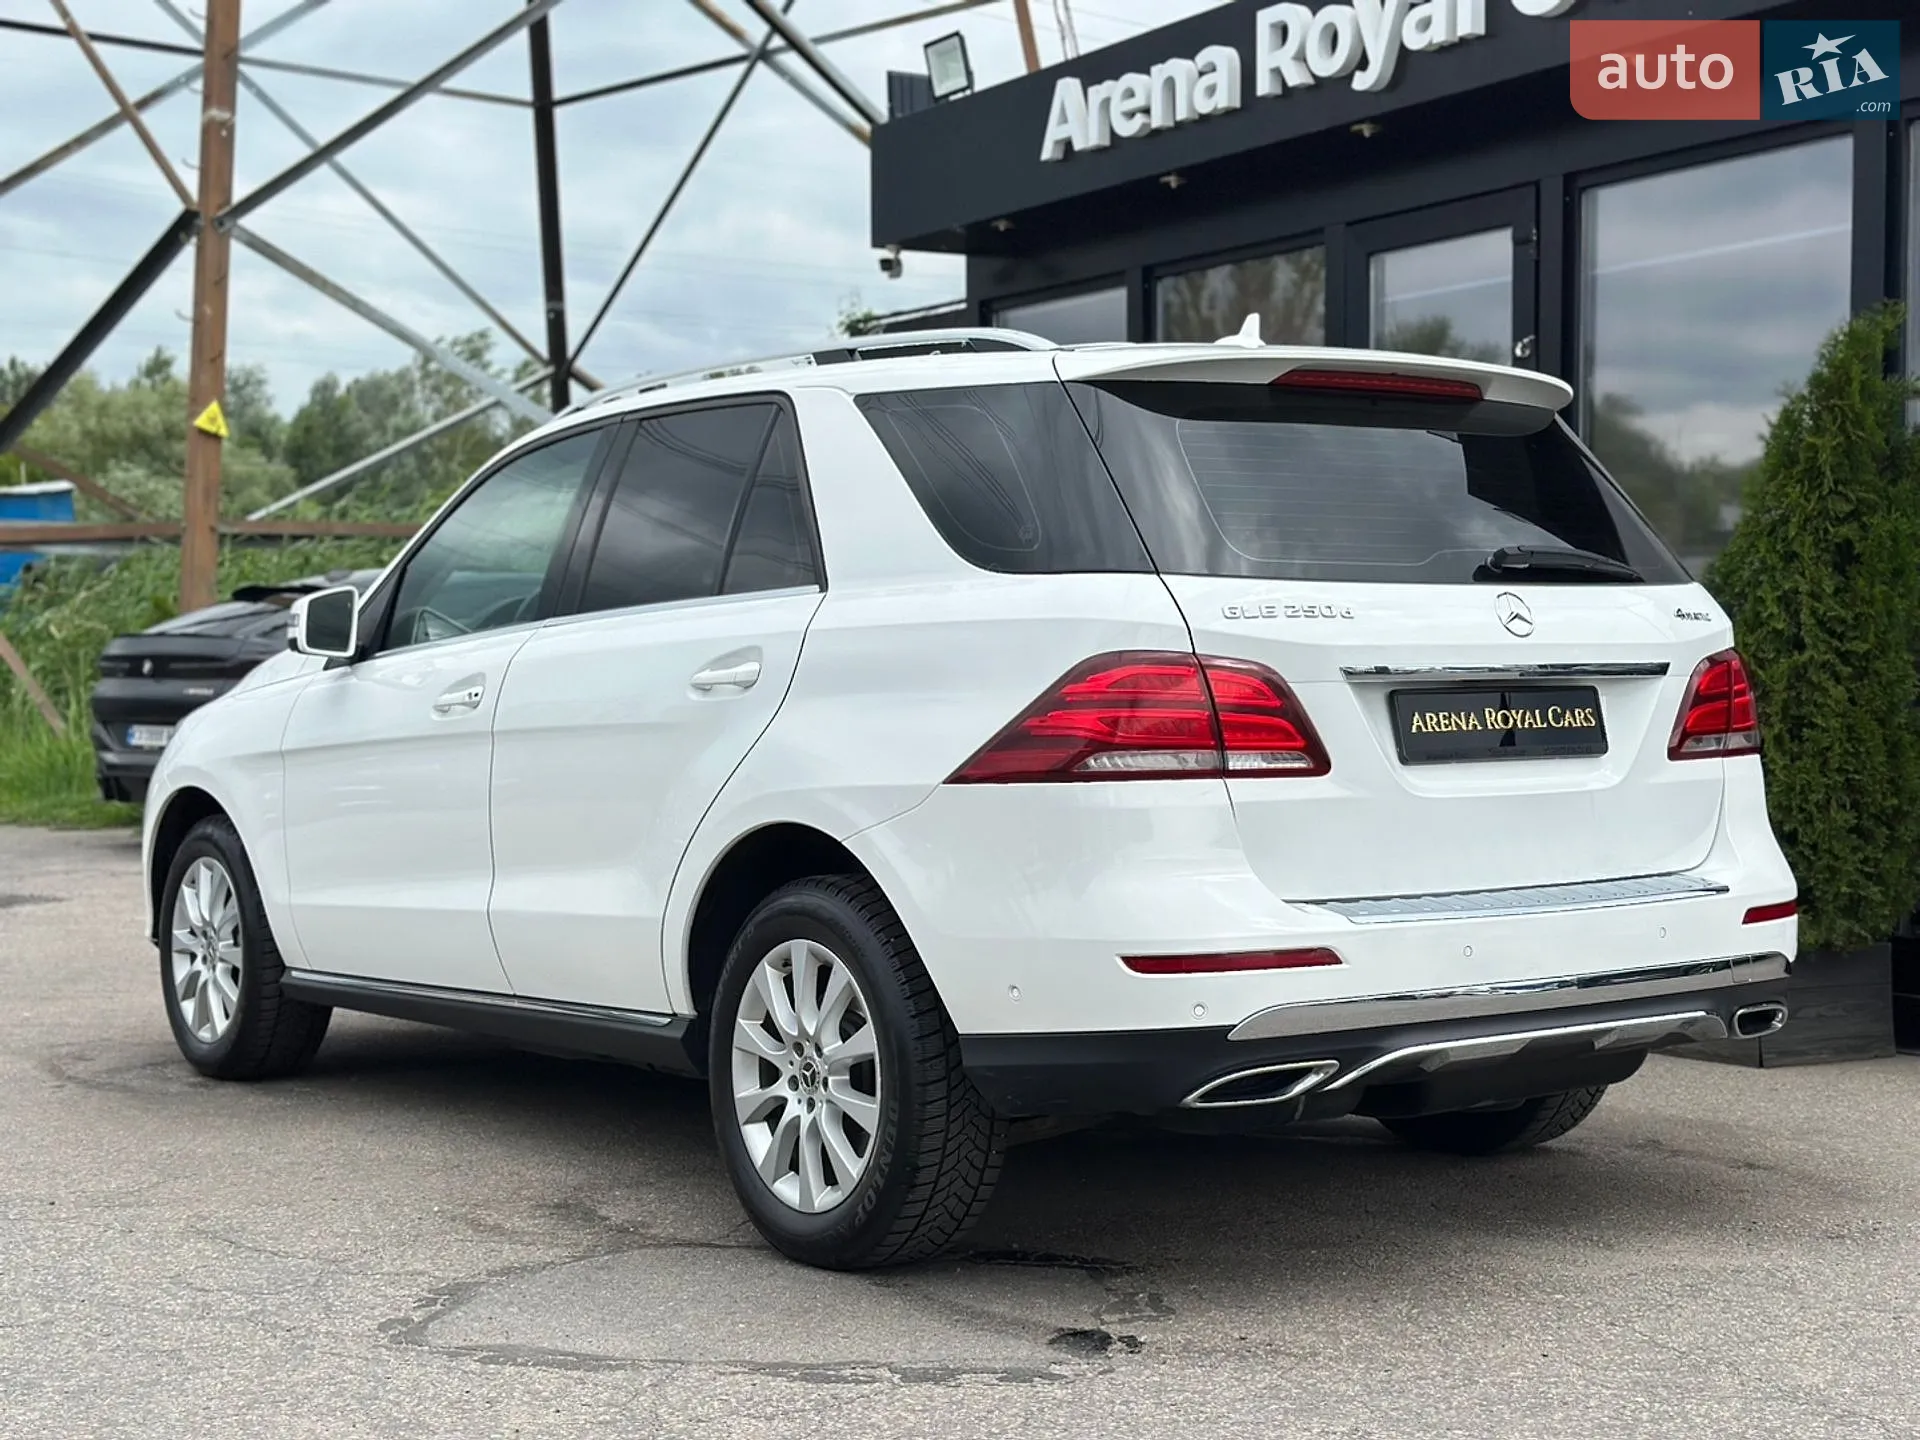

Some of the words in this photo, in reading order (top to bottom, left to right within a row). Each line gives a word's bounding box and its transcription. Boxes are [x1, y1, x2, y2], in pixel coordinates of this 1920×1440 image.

[1040, 44, 1242, 162] Arena
[1221, 602, 1279, 620] GLE
[1283, 601, 1355, 620] 250d
